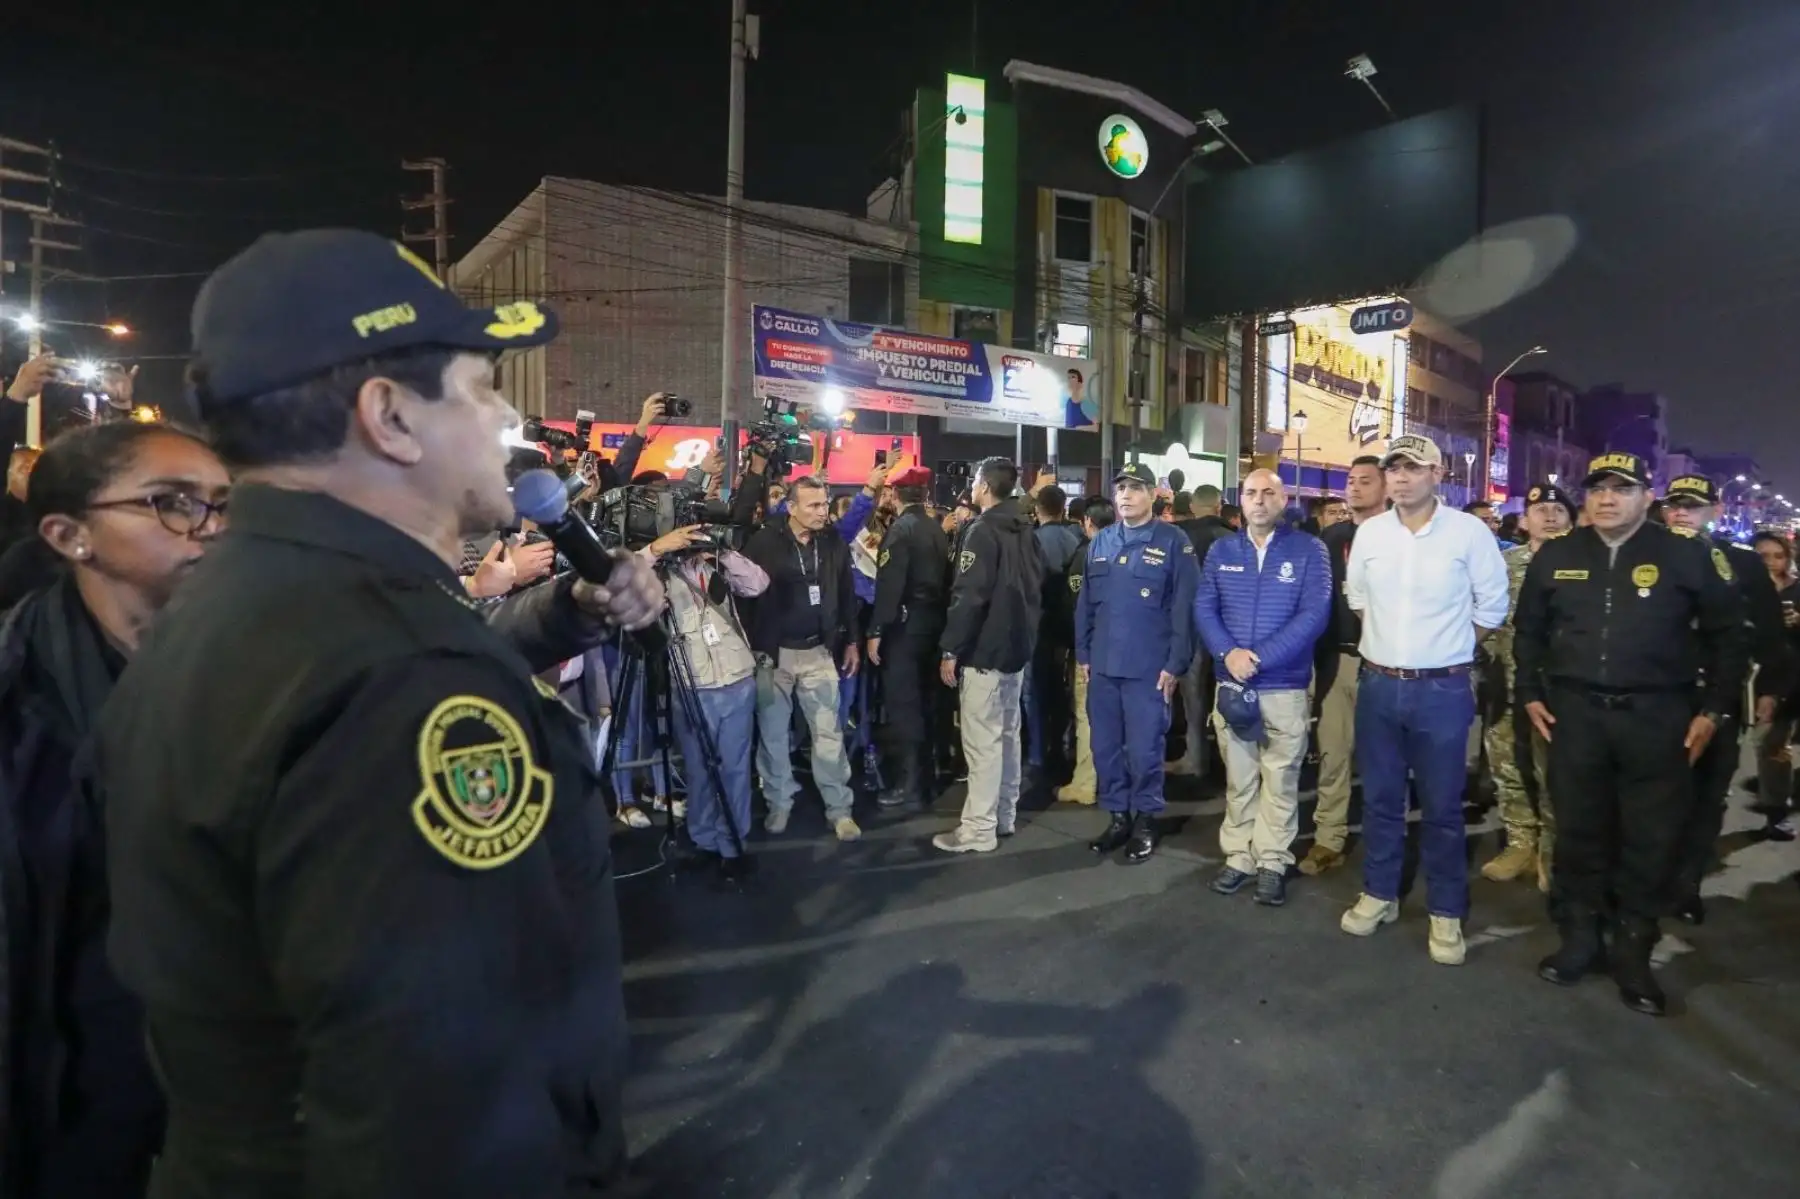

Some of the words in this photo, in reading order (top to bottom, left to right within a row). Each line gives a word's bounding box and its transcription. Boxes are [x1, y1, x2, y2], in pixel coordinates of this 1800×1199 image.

[775, 320, 820, 336] CALLAO
[894, 338, 968, 357] VENCIMIENTO
[770, 360, 827, 376] DIFERENCIA
[858, 347, 927, 369] IMPUESTO
[929, 357, 982, 376] PREDIAL
[878, 364, 888, 377] Y
[891, 366, 966, 386] VEHICULAR
